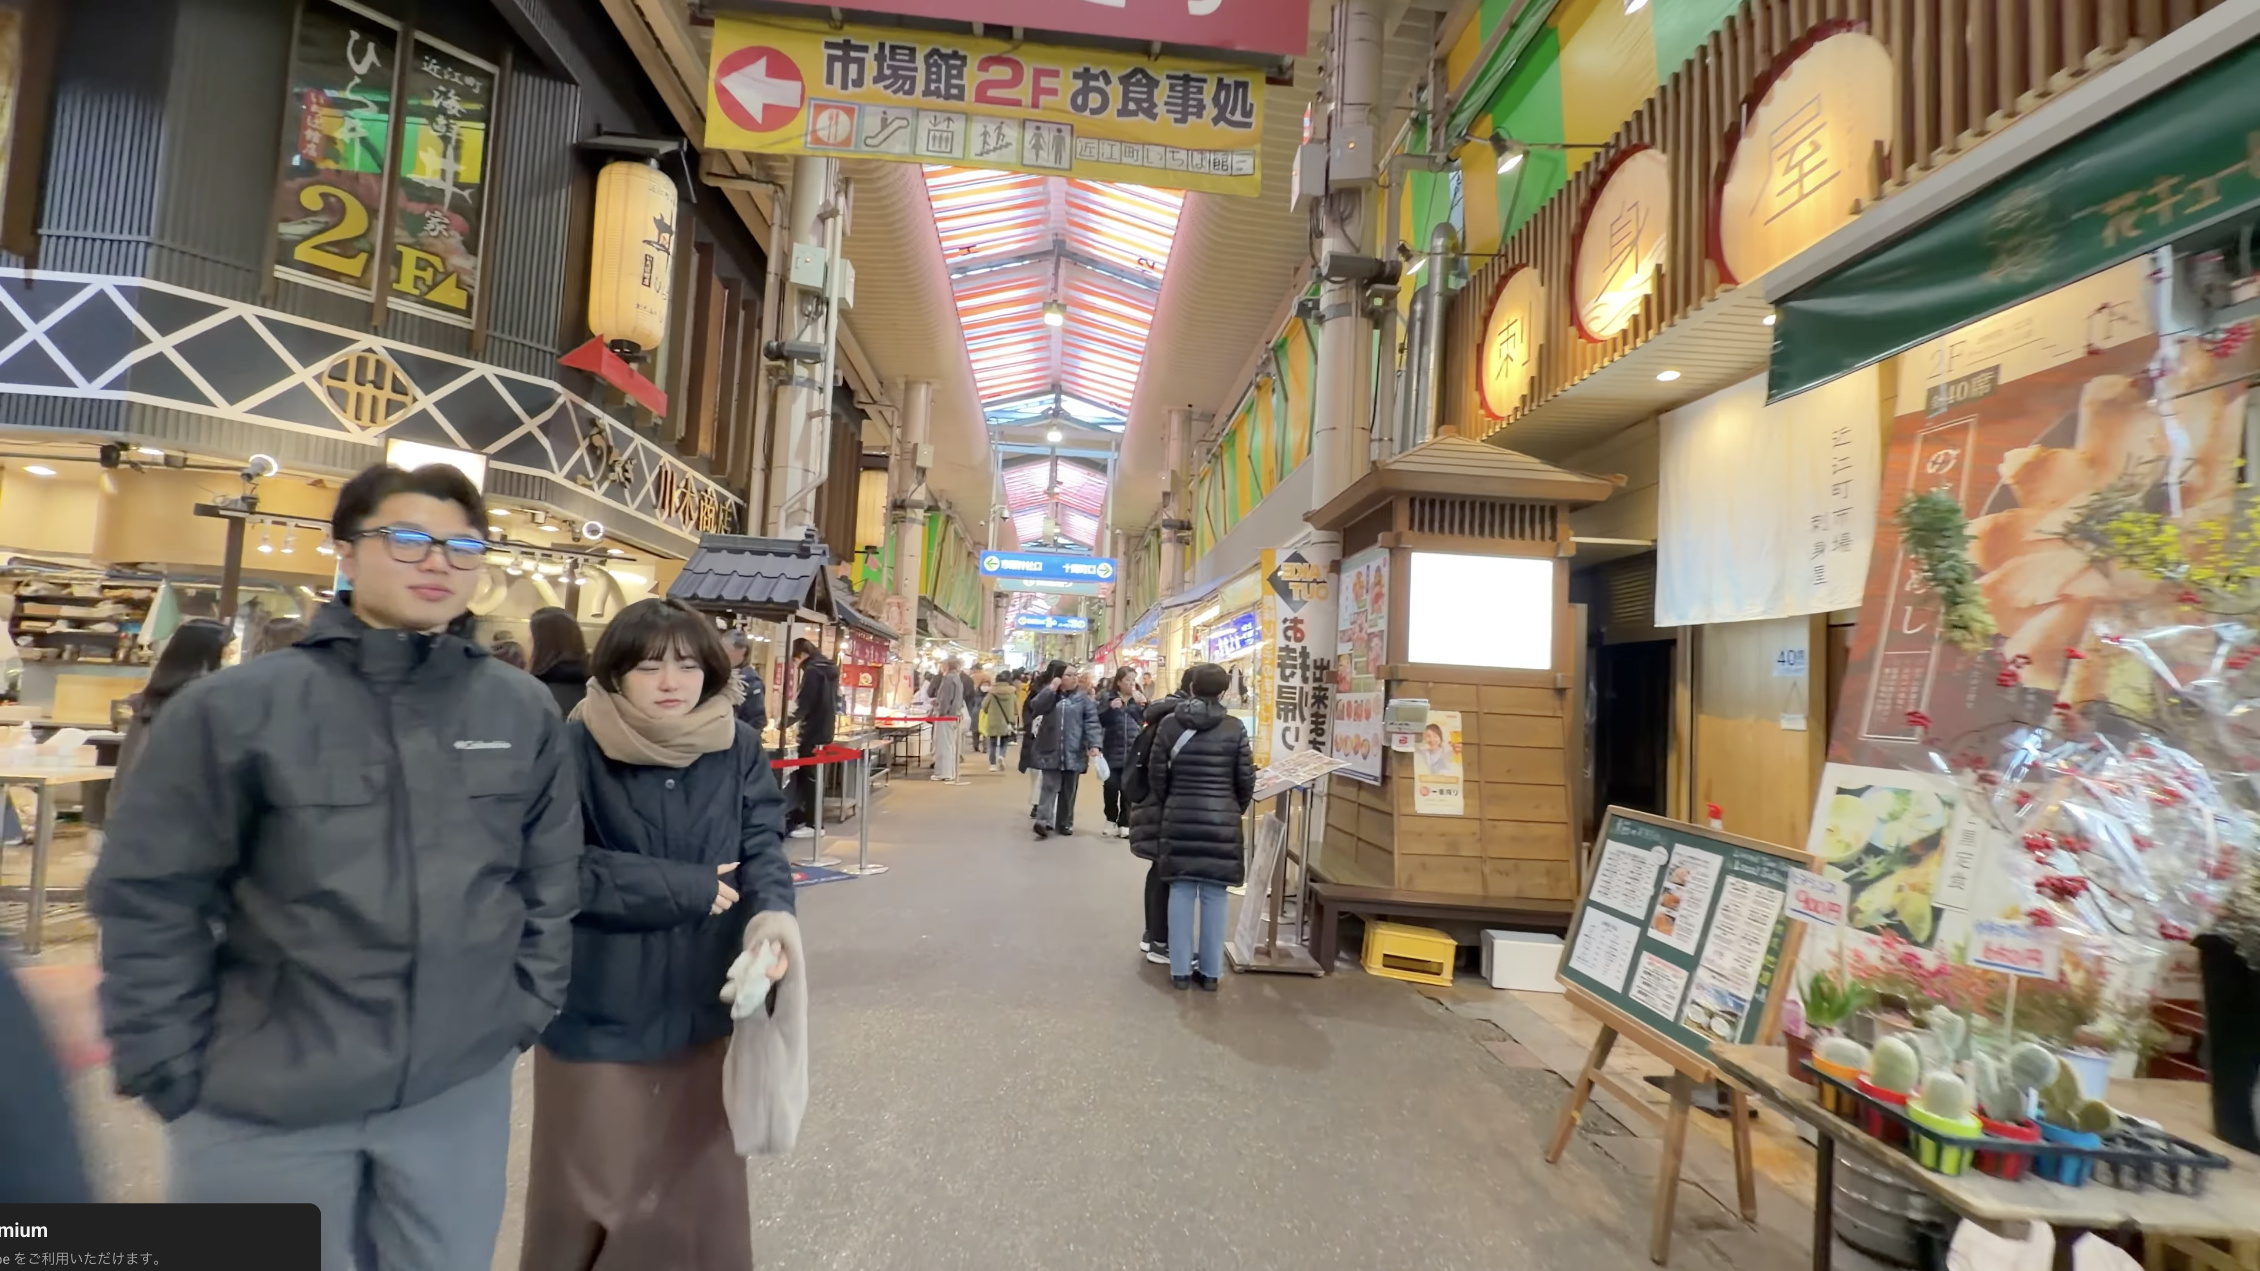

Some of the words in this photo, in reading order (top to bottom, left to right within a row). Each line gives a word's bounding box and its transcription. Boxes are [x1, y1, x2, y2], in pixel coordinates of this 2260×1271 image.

[421, 54, 484, 95] 近江町
[823, 39, 1256, 130] 市場館2Fお食事処
[1496, 299, 1532, 381] 刺
[1595, 199, 1650, 303] 身
[1750, 92, 1842, 226] 屋
